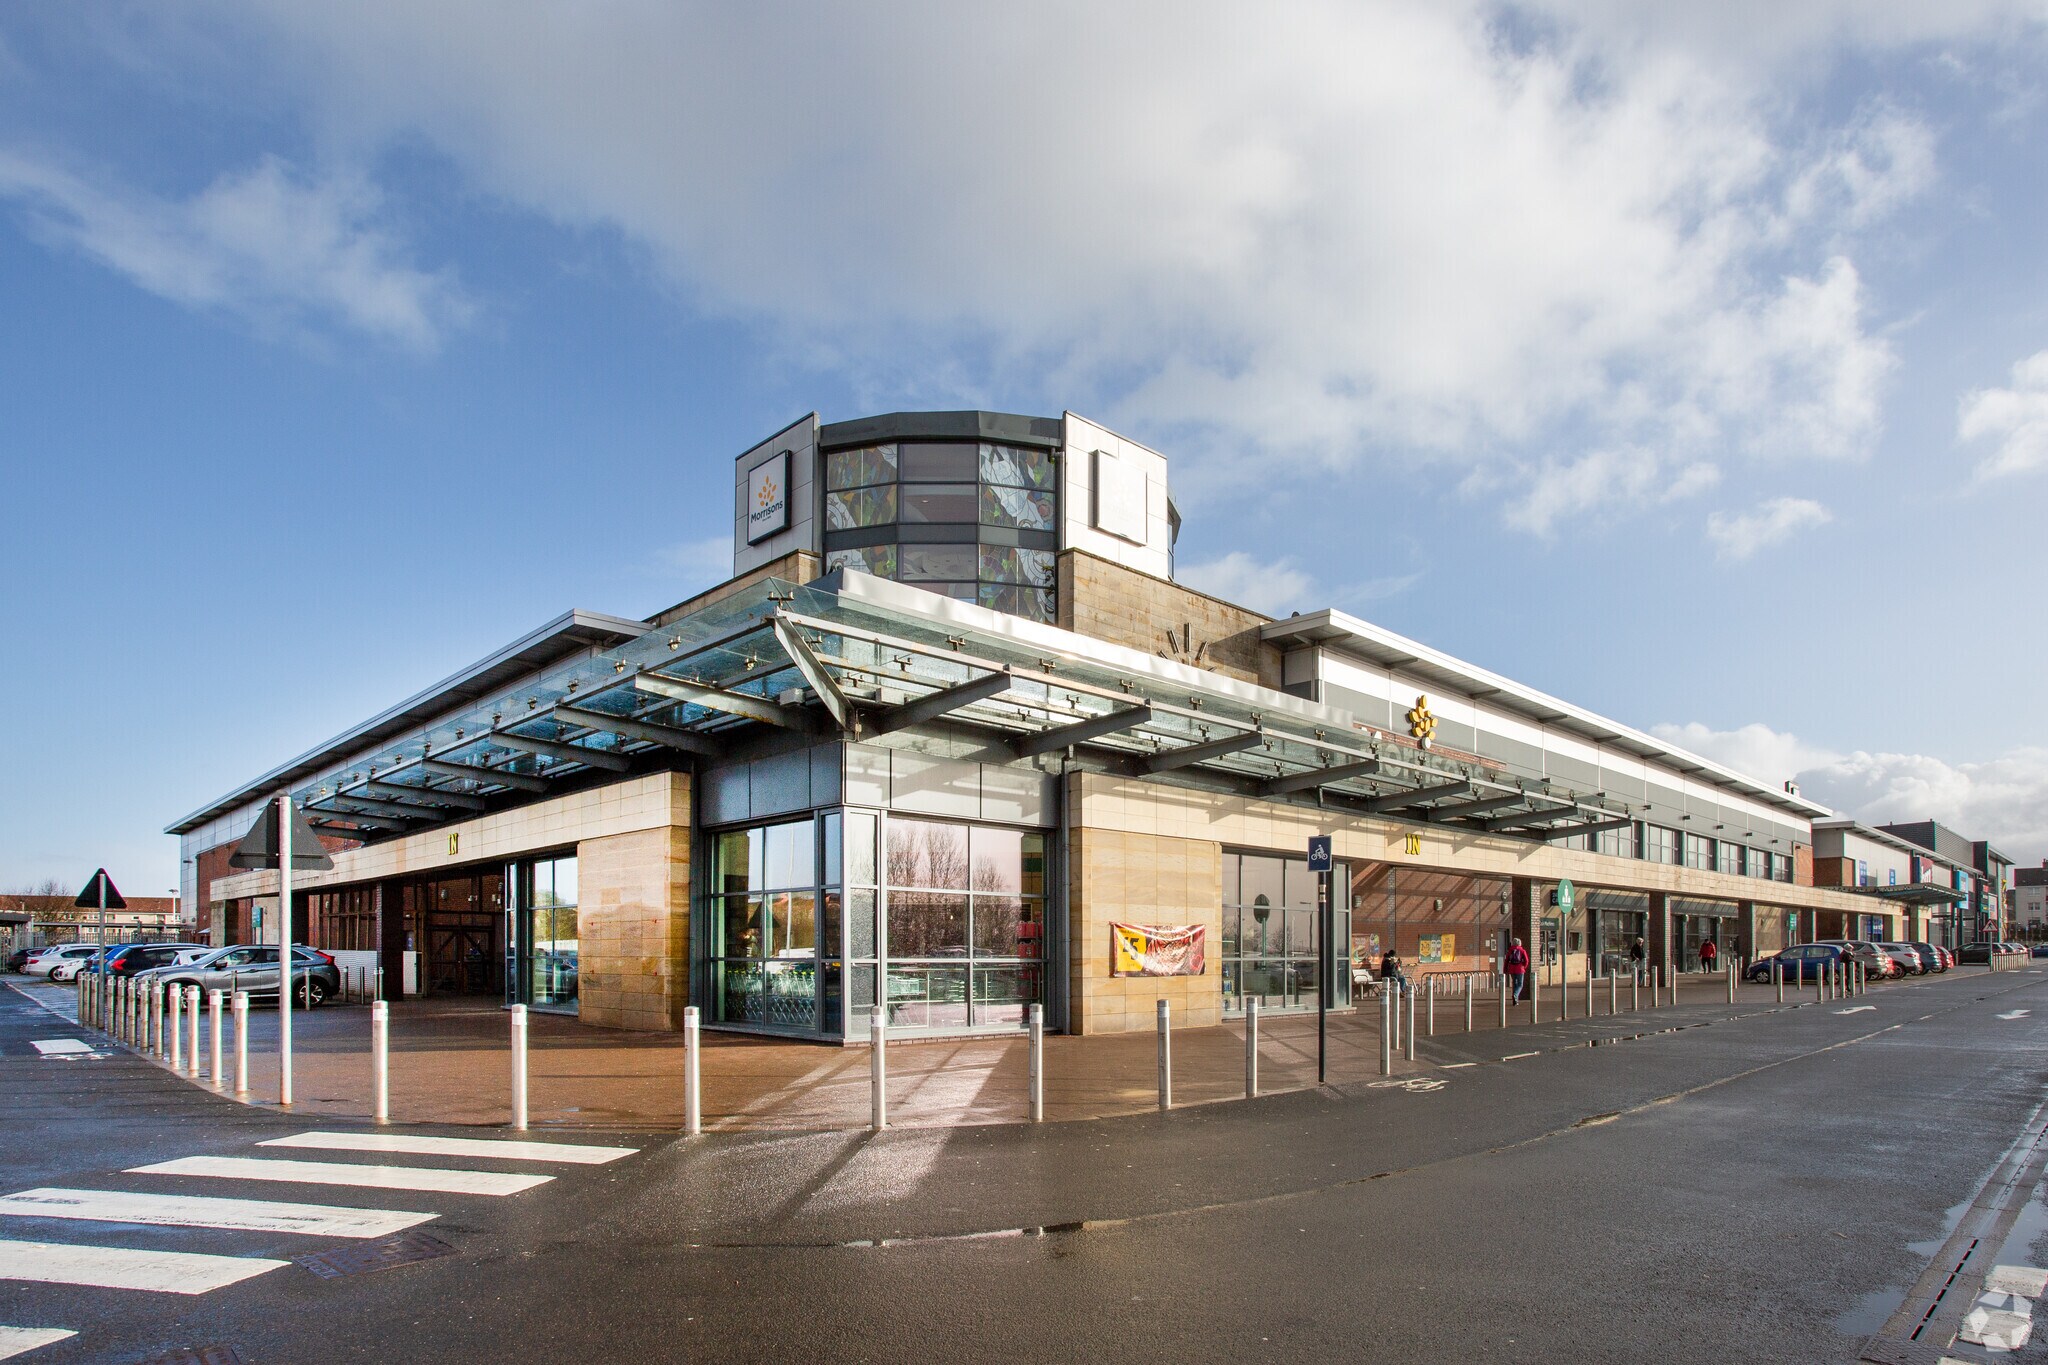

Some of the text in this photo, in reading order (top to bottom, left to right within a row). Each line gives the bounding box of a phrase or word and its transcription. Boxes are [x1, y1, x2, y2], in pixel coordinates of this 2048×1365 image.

[751, 501, 783, 523] Morrisons
[447, 832, 459, 856] IN
[1405, 833, 1421, 855] IN
